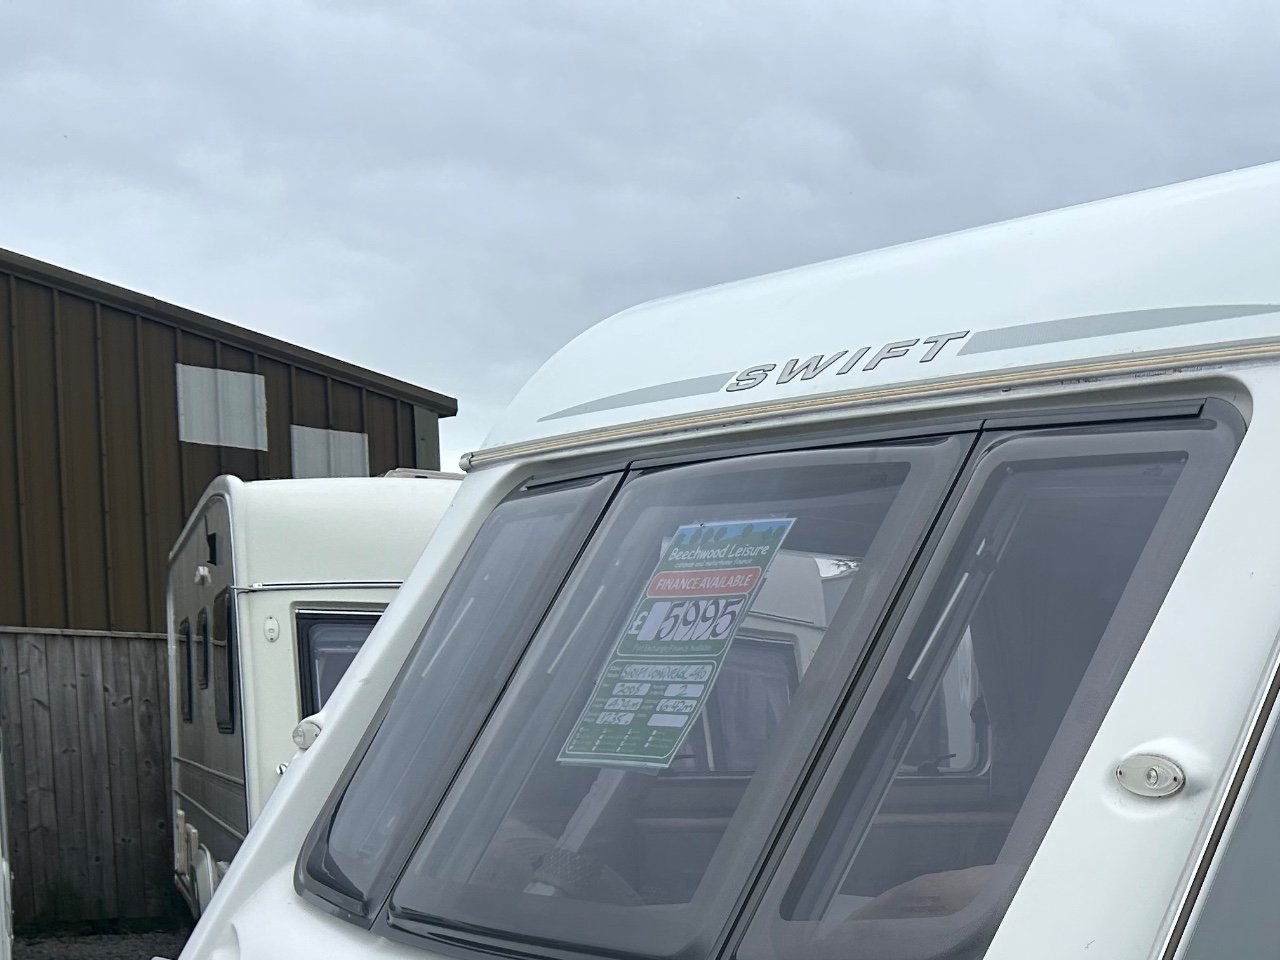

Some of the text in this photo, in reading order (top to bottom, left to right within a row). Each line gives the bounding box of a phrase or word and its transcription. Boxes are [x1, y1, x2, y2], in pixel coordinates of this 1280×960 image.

[725, 330, 970, 392] SWIFT
[668, 544, 770, 561] Beechwood Leisure
[655, 574, 753, 591] FINANCE AVAILABLE
[655, 599, 744, 641] 5995
